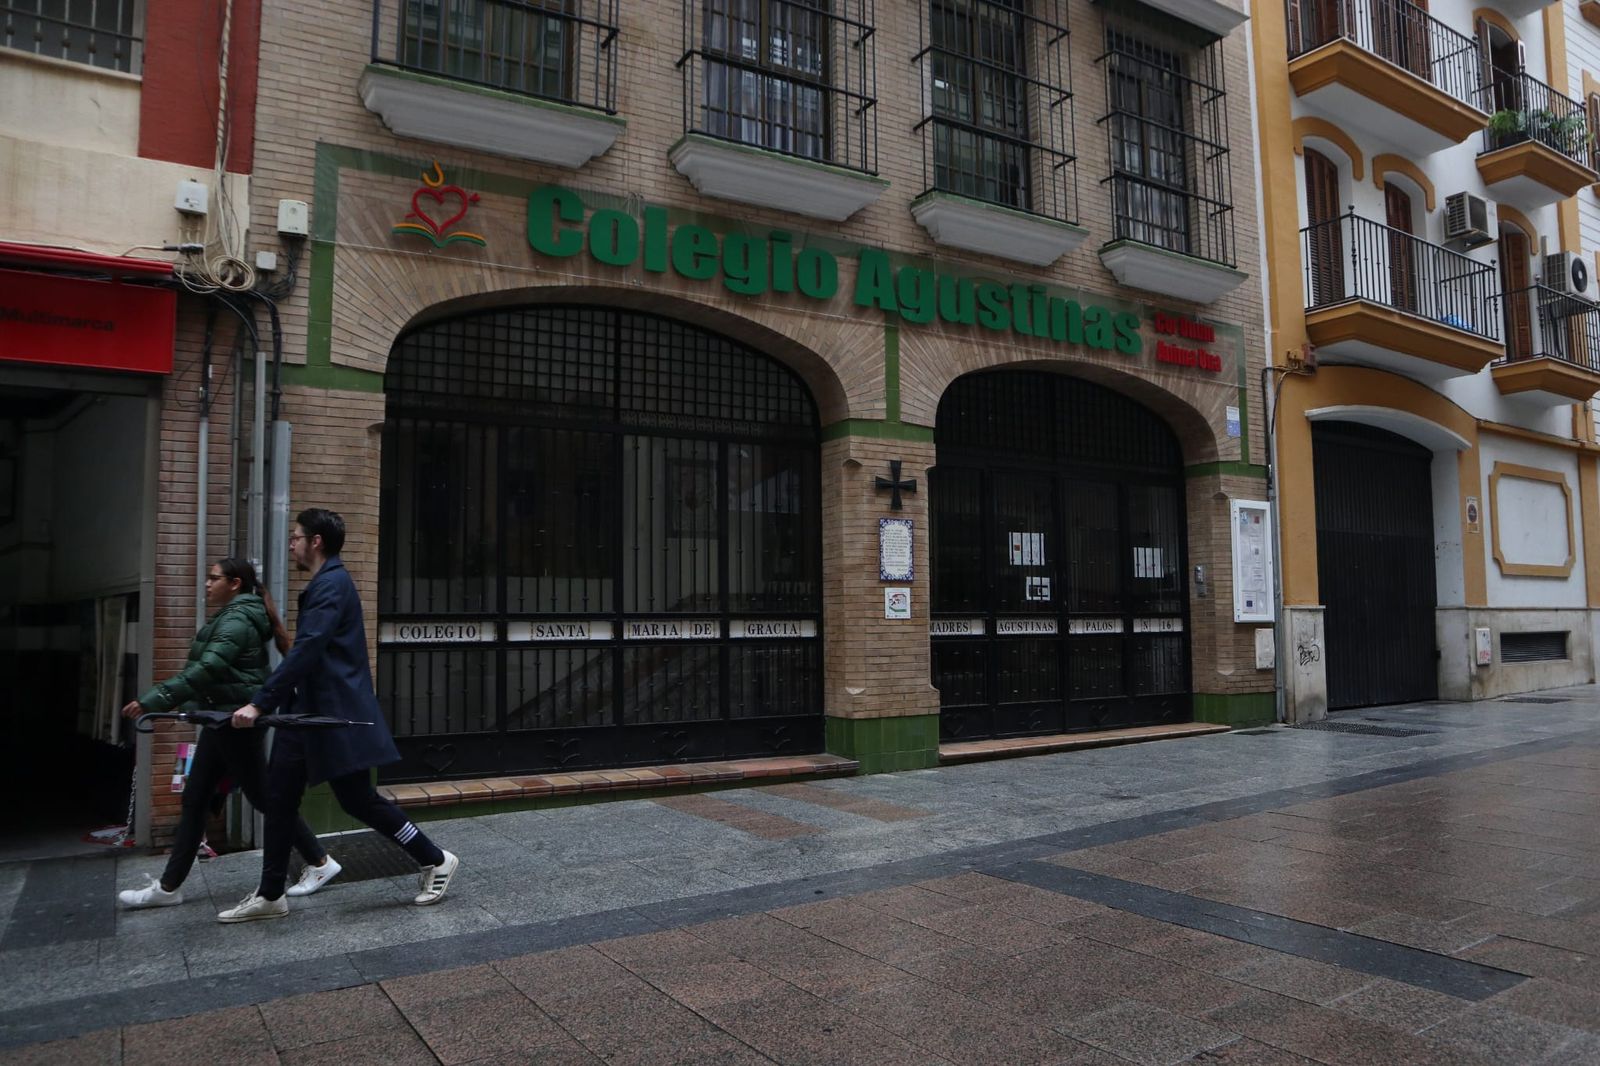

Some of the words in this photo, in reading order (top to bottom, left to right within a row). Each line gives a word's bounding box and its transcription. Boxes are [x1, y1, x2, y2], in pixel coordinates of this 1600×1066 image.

[527, 186, 838, 299] Colegio
[854, 249, 1142, 355] Agustinas
[399, 624, 476, 640] COLEGIO
[536, 624, 586, 638] SANTA
[632, 623, 679, 637] MARIA
[694, 623, 712, 636] DE
[747, 622, 798, 635] GRACIA
[998, 621, 1053, 632] AGUSTINAS
[1086, 621, 1113, 631] PALOS
[1162, 621, 1172, 631] 16
